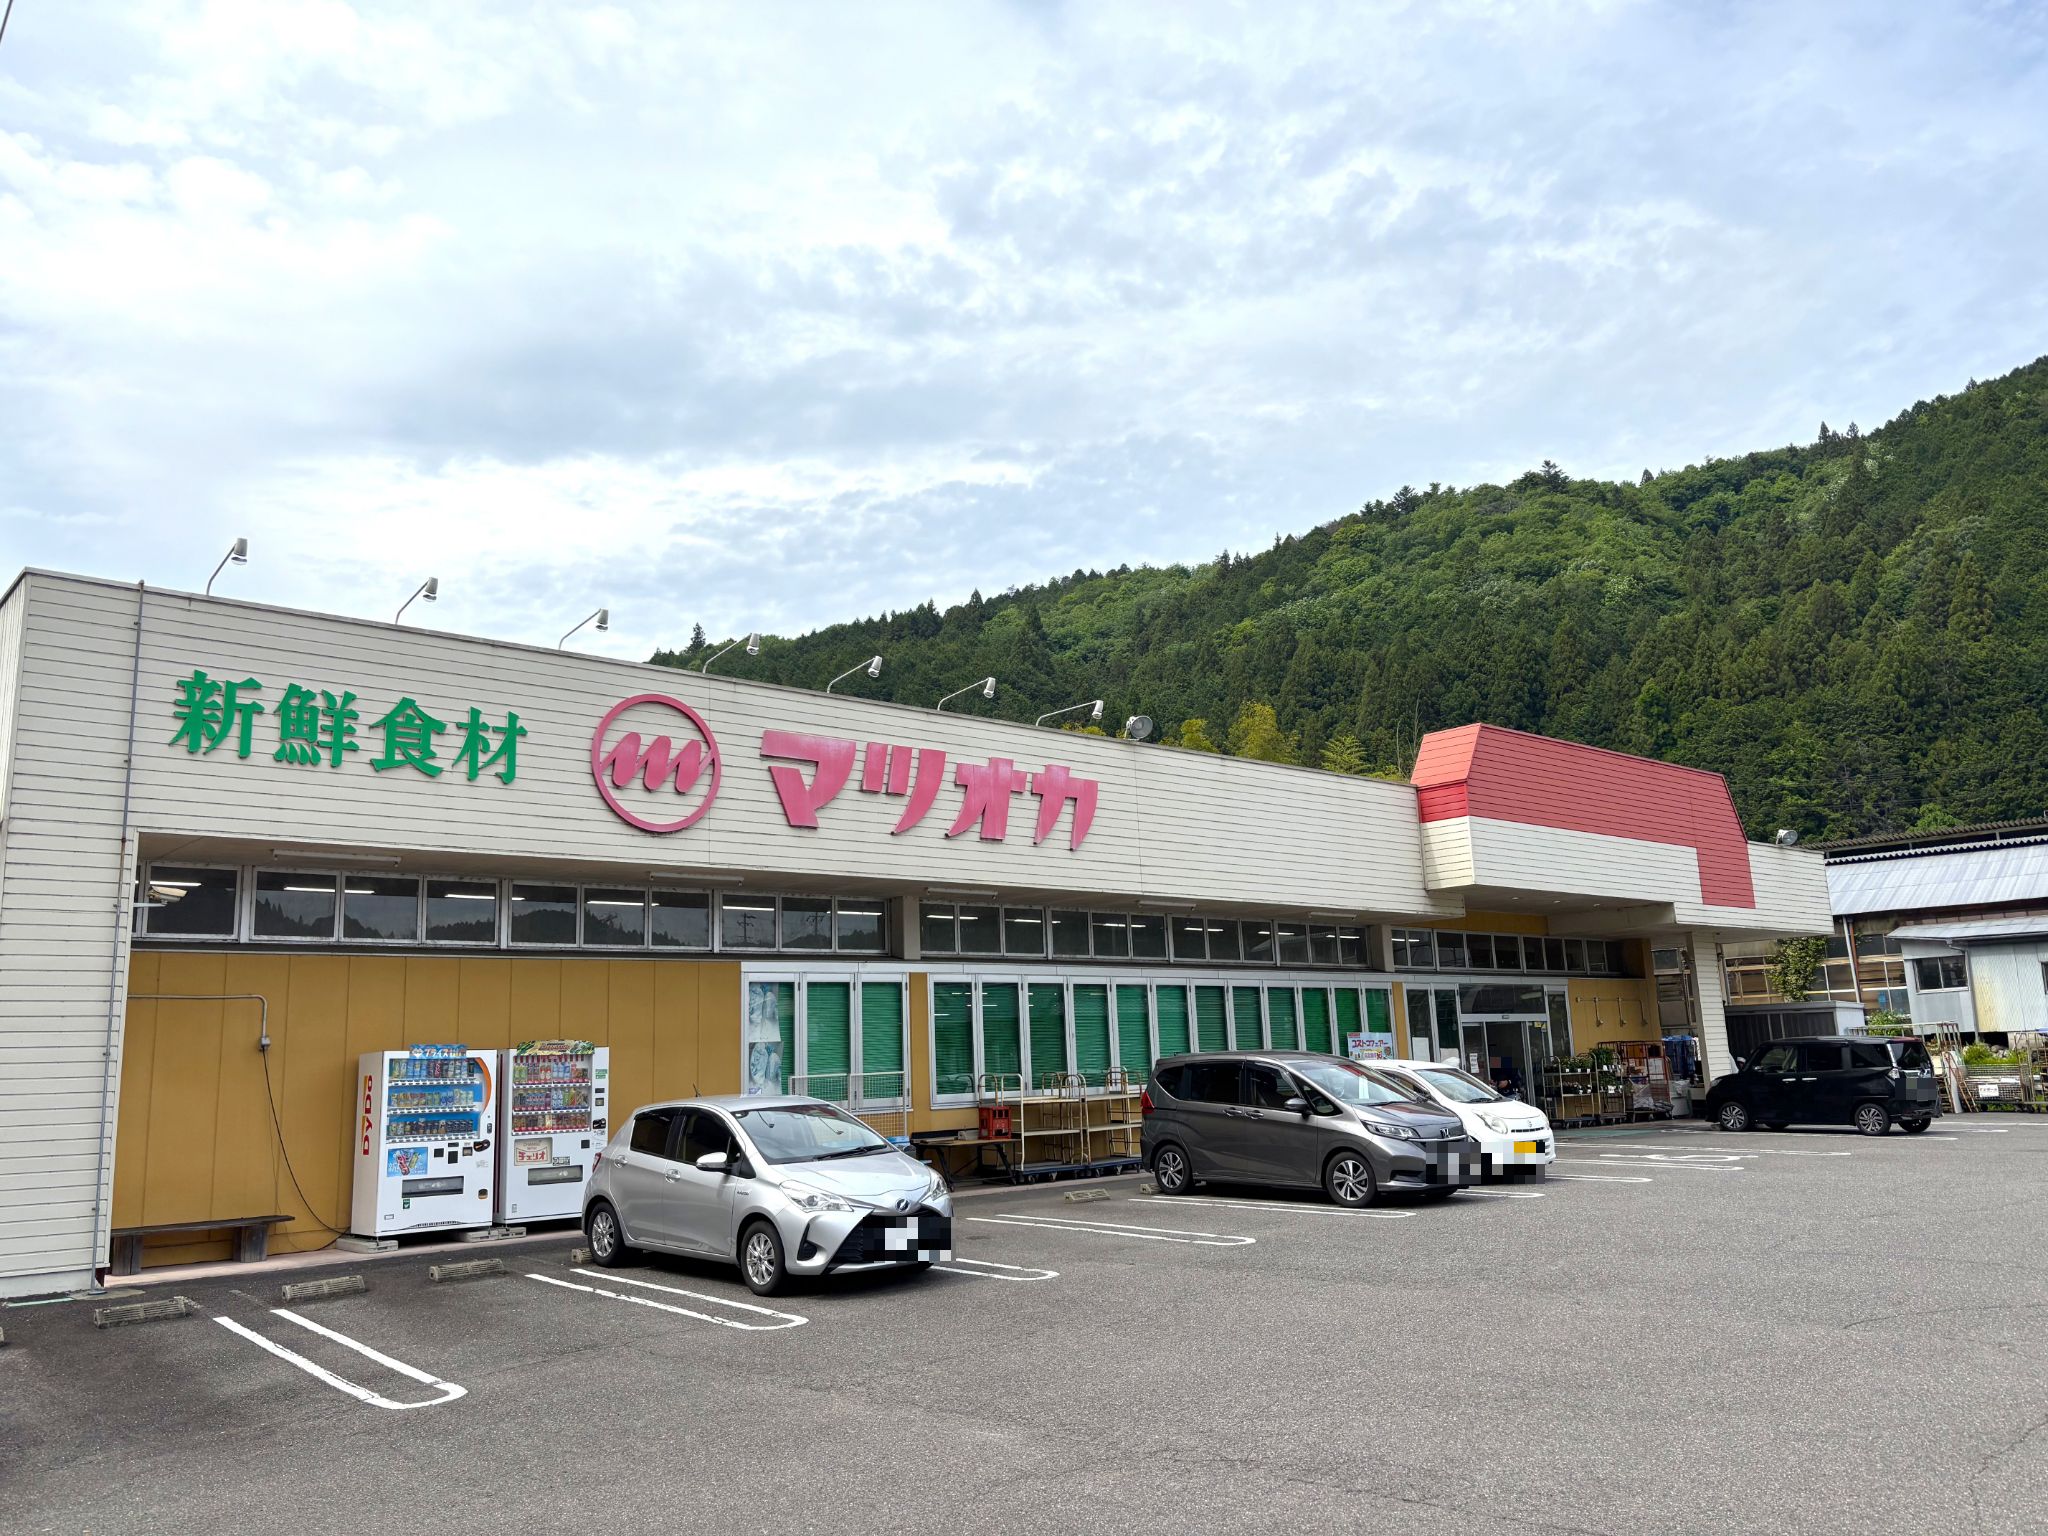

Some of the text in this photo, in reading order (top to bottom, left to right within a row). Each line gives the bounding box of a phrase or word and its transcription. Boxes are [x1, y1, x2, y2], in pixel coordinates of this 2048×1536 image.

[168, 669, 528, 785] 新鮮食材
[760, 729, 1098, 852] マツオカ
[1352, 1039, 1389, 1049] コストコフェアー
[363, 1075, 373, 1156] DyDo
[518, 1150, 545, 1161] チェリオ
